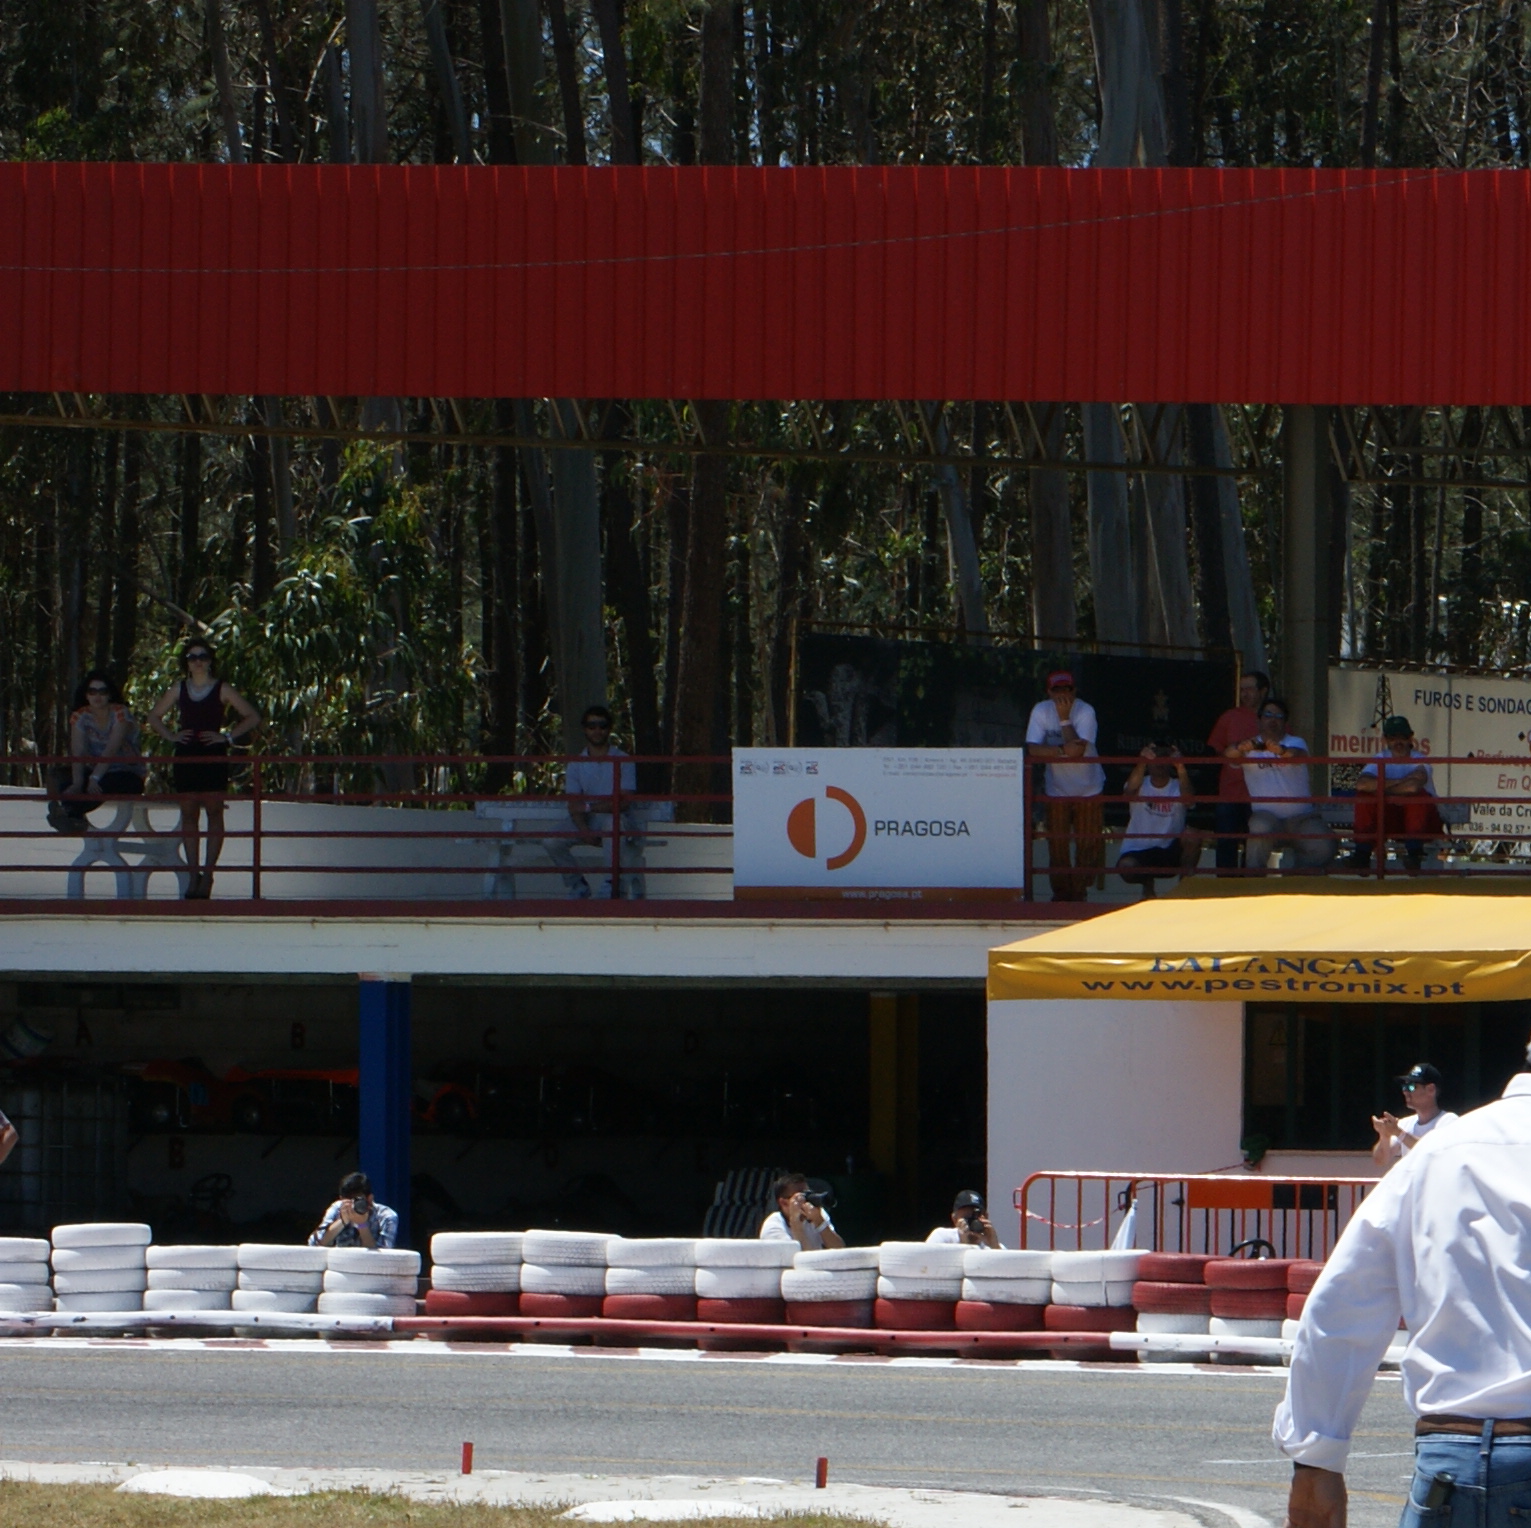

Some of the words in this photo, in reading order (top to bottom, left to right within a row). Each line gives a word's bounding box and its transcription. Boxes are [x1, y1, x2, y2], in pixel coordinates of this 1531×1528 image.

[1414, 689, 1462, 710] FUROS
[1466, 695, 1473, 710] E
[1498, 774, 1518, 789] Em
[1473, 803, 1496, 816] Vale
[1499, 804, 1512, 816] da
[874, 820, 971, 837] PRAGOSA
[841, 889, 923, 900] www.pragosa.pt
[1081, 978, 1465, 998] www.pestronix.pt
